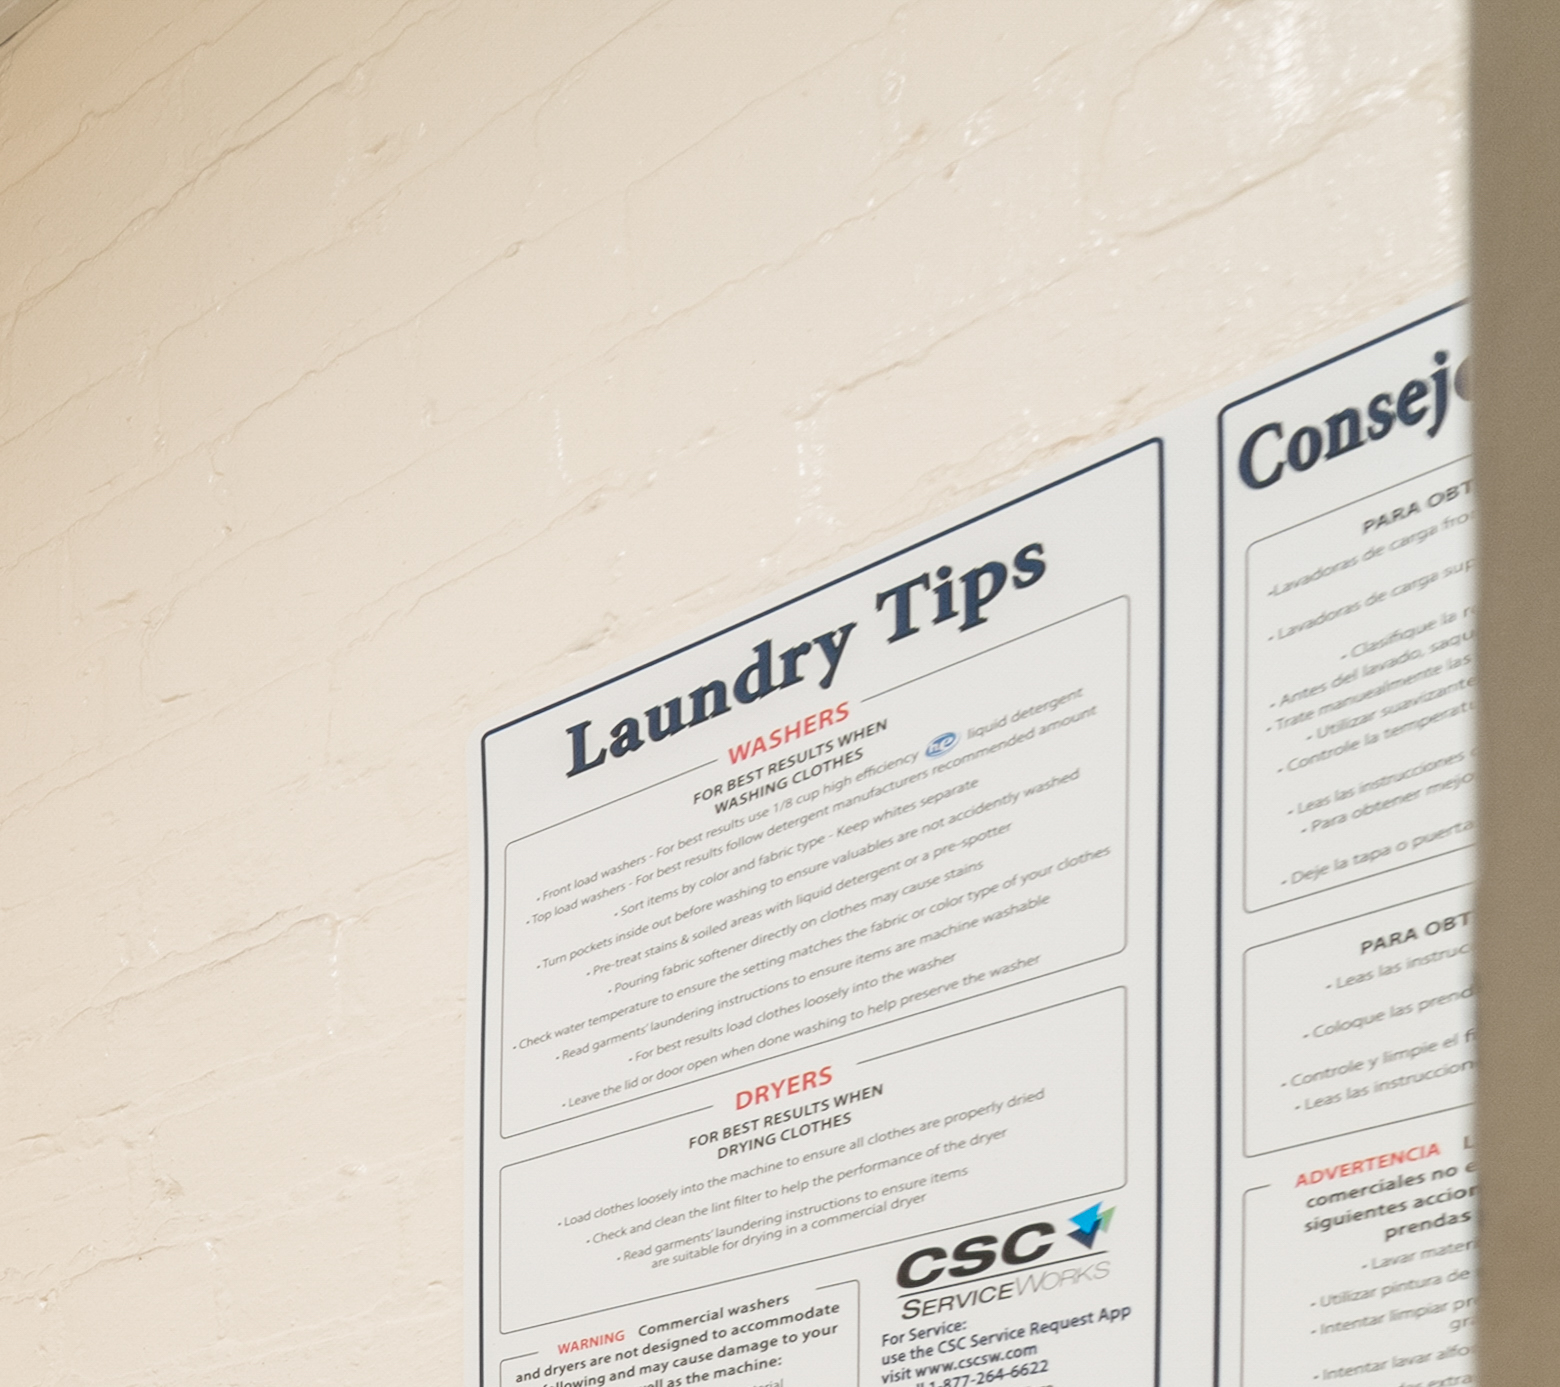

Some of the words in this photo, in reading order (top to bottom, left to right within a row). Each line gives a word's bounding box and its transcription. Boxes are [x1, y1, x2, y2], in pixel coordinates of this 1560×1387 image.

[565, 621, 858, 779] Laundry
[875, 542, 1046, 645] Tips
[693, 783, 723, 805] FOR
[726, 766, 765, 792] BEST
[767, 739, 834, 776] RESULTS
[837, 718, 888, 748] WHEN
[728, 701, 850, 765] WASHERS
[714, 776, 788, 815] WASHING
[791, 747, 864, 785] CLOTHES
[736, 1065, 833, 1111] DRYERS
[1295, 1142, 1441, 1188] ADVERTENCIA
[896, 1221, 1056, 1289] CSC
[557, 1329, 625, 1355] WARNING
[881, 1367, 912, 1385] visit
[915, 1344, 1038, 1378] www.cscsw.com
